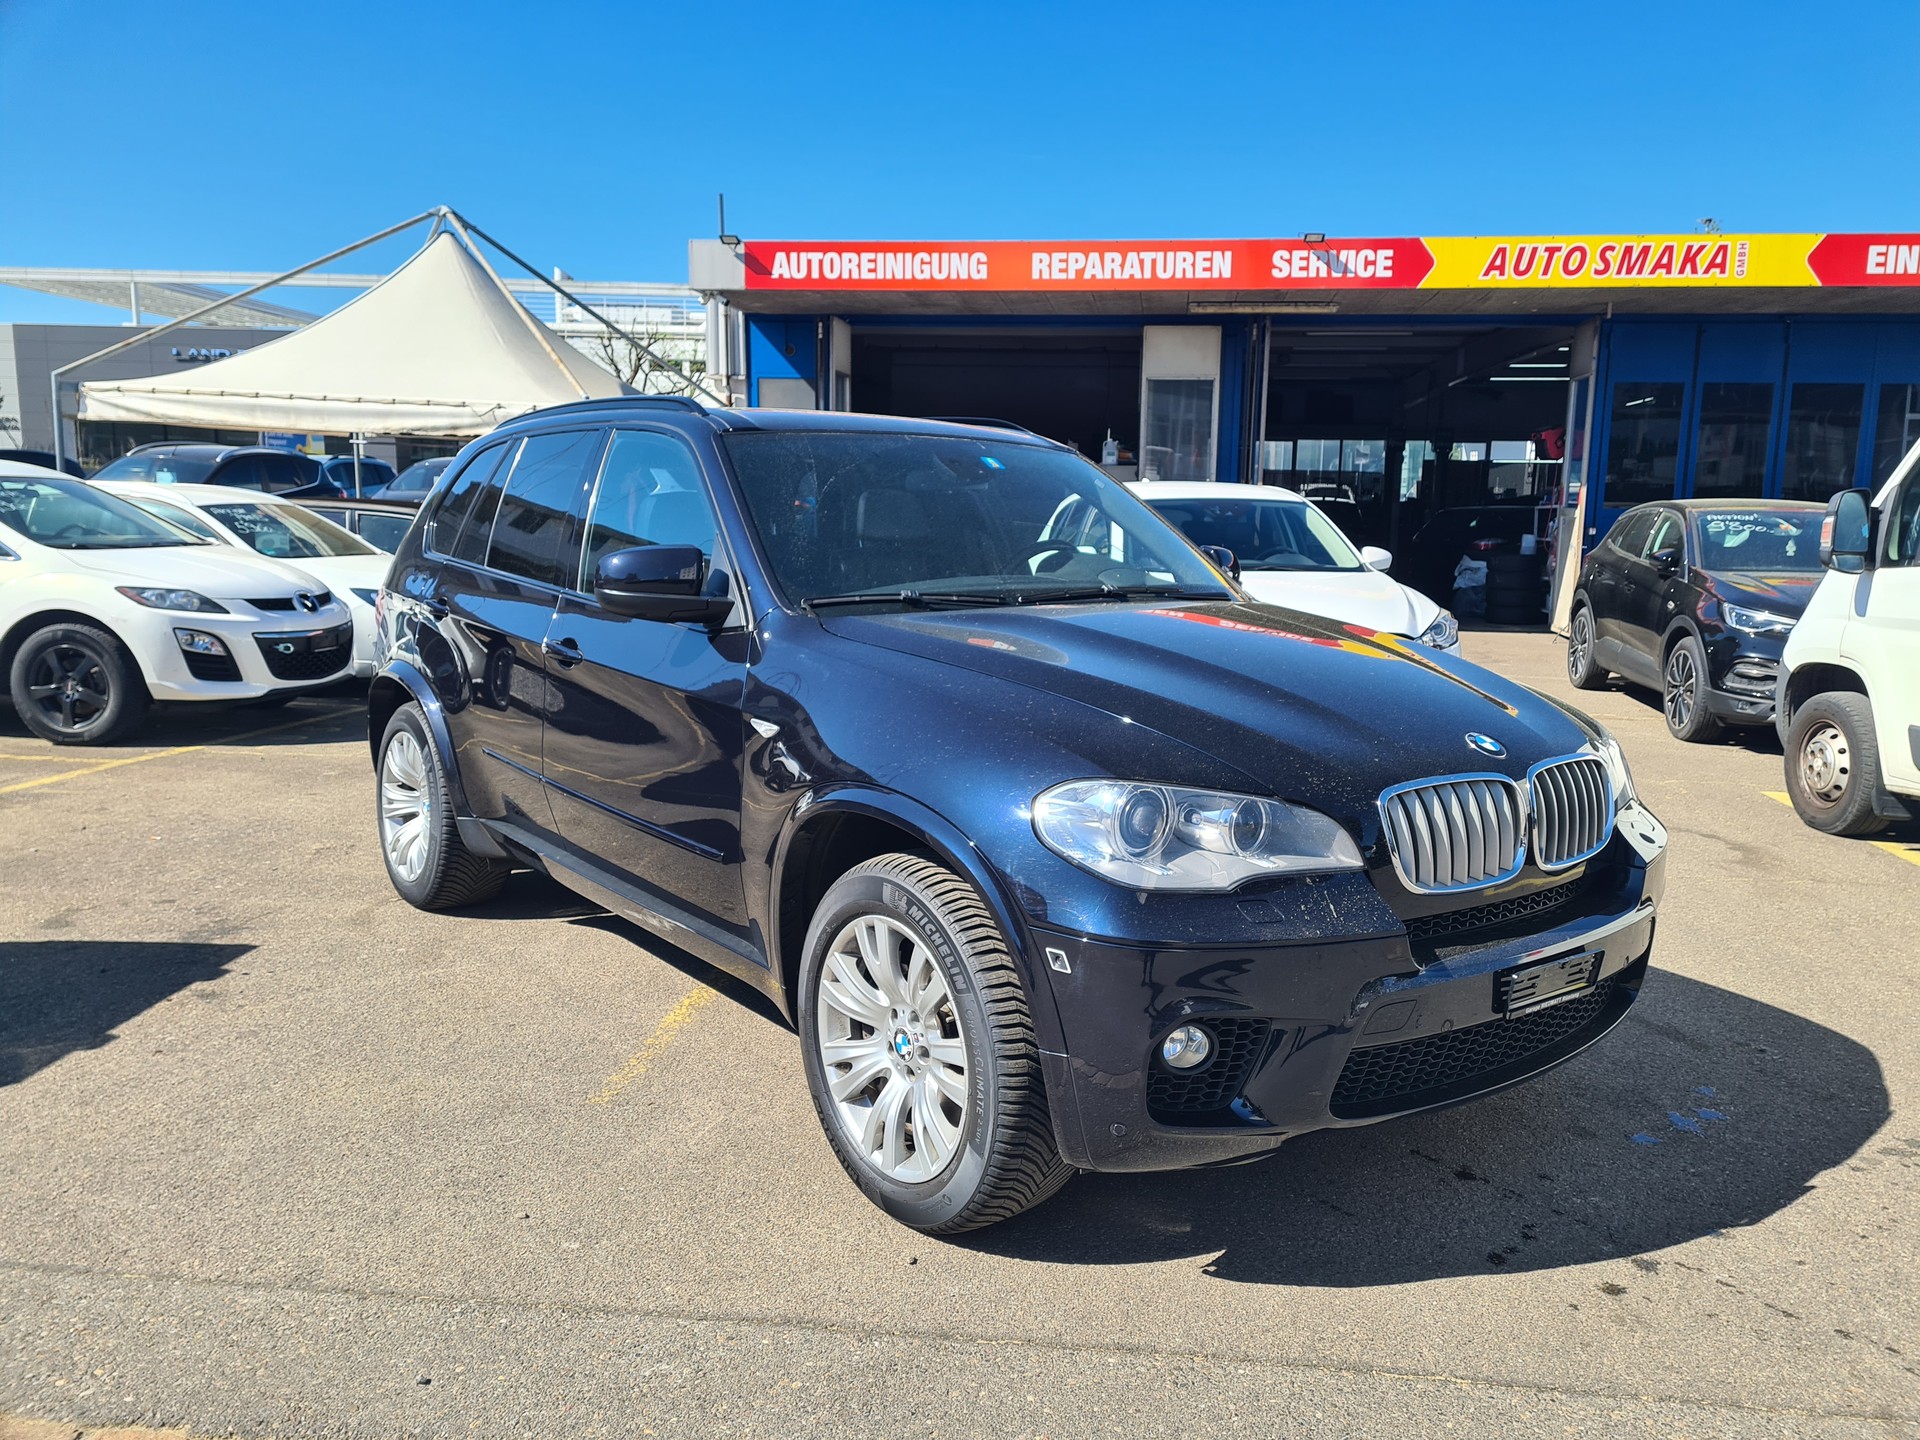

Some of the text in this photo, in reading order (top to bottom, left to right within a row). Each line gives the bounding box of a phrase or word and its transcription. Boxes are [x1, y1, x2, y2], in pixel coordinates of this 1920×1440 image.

[771, 251, 988, 280] AUTOREINIGUNG
[1031, 250, 1232, 280] REPARATUREN
[1271, 248, 1394, 279] SERVICE
[1480, 241, 1731, 279] AUTO SMAKA
[1735, 241, 1749, 278] GMBH
[1866, 244, 1920, 275] EIN
[171, 347, 232, 360] LAND
[908, 905, 967, 990] MICHELIN
[965, 1009, 985, 1116] CROSSCLIMATE
